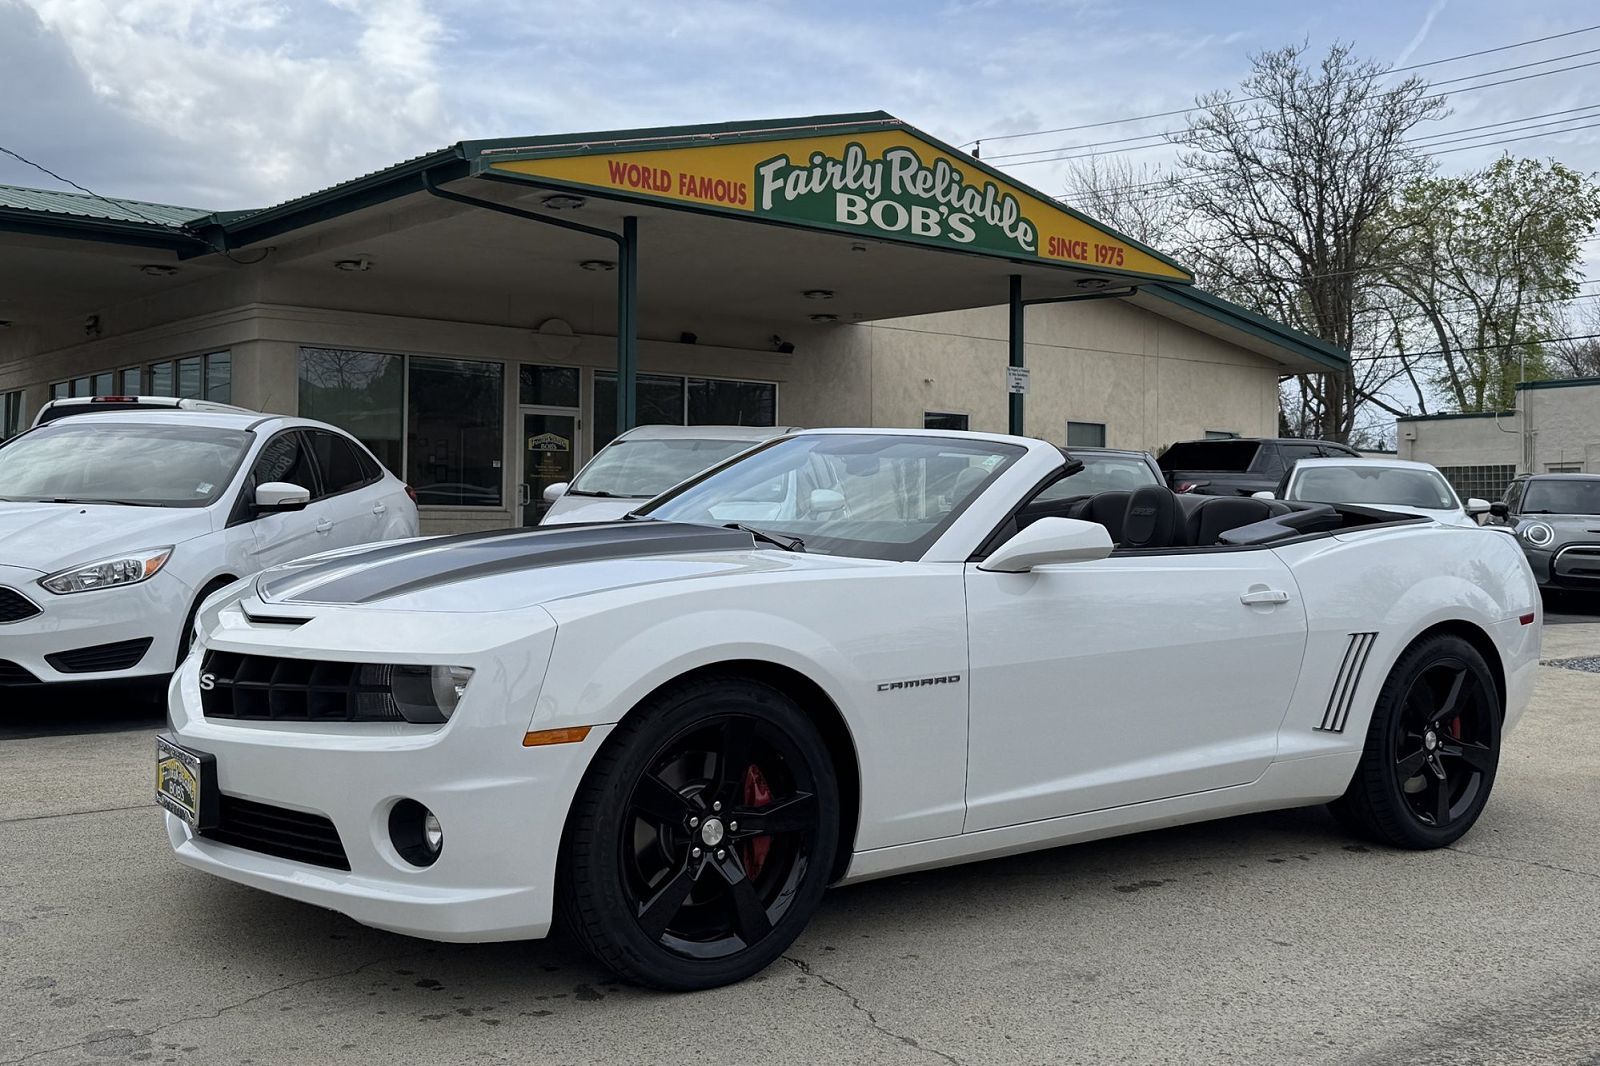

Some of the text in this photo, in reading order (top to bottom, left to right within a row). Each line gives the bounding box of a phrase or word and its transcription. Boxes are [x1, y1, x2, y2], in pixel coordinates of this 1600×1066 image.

[608, 160, 747, 205] WORLD FAMOUS
[759, 144, 1036, 252] Fairly Reliable
[836, 192, 977, 244] BOB'S
[1048, 236, 1125, 267] SINCE 1975
[877, 675, 961, 692] CAMARO
